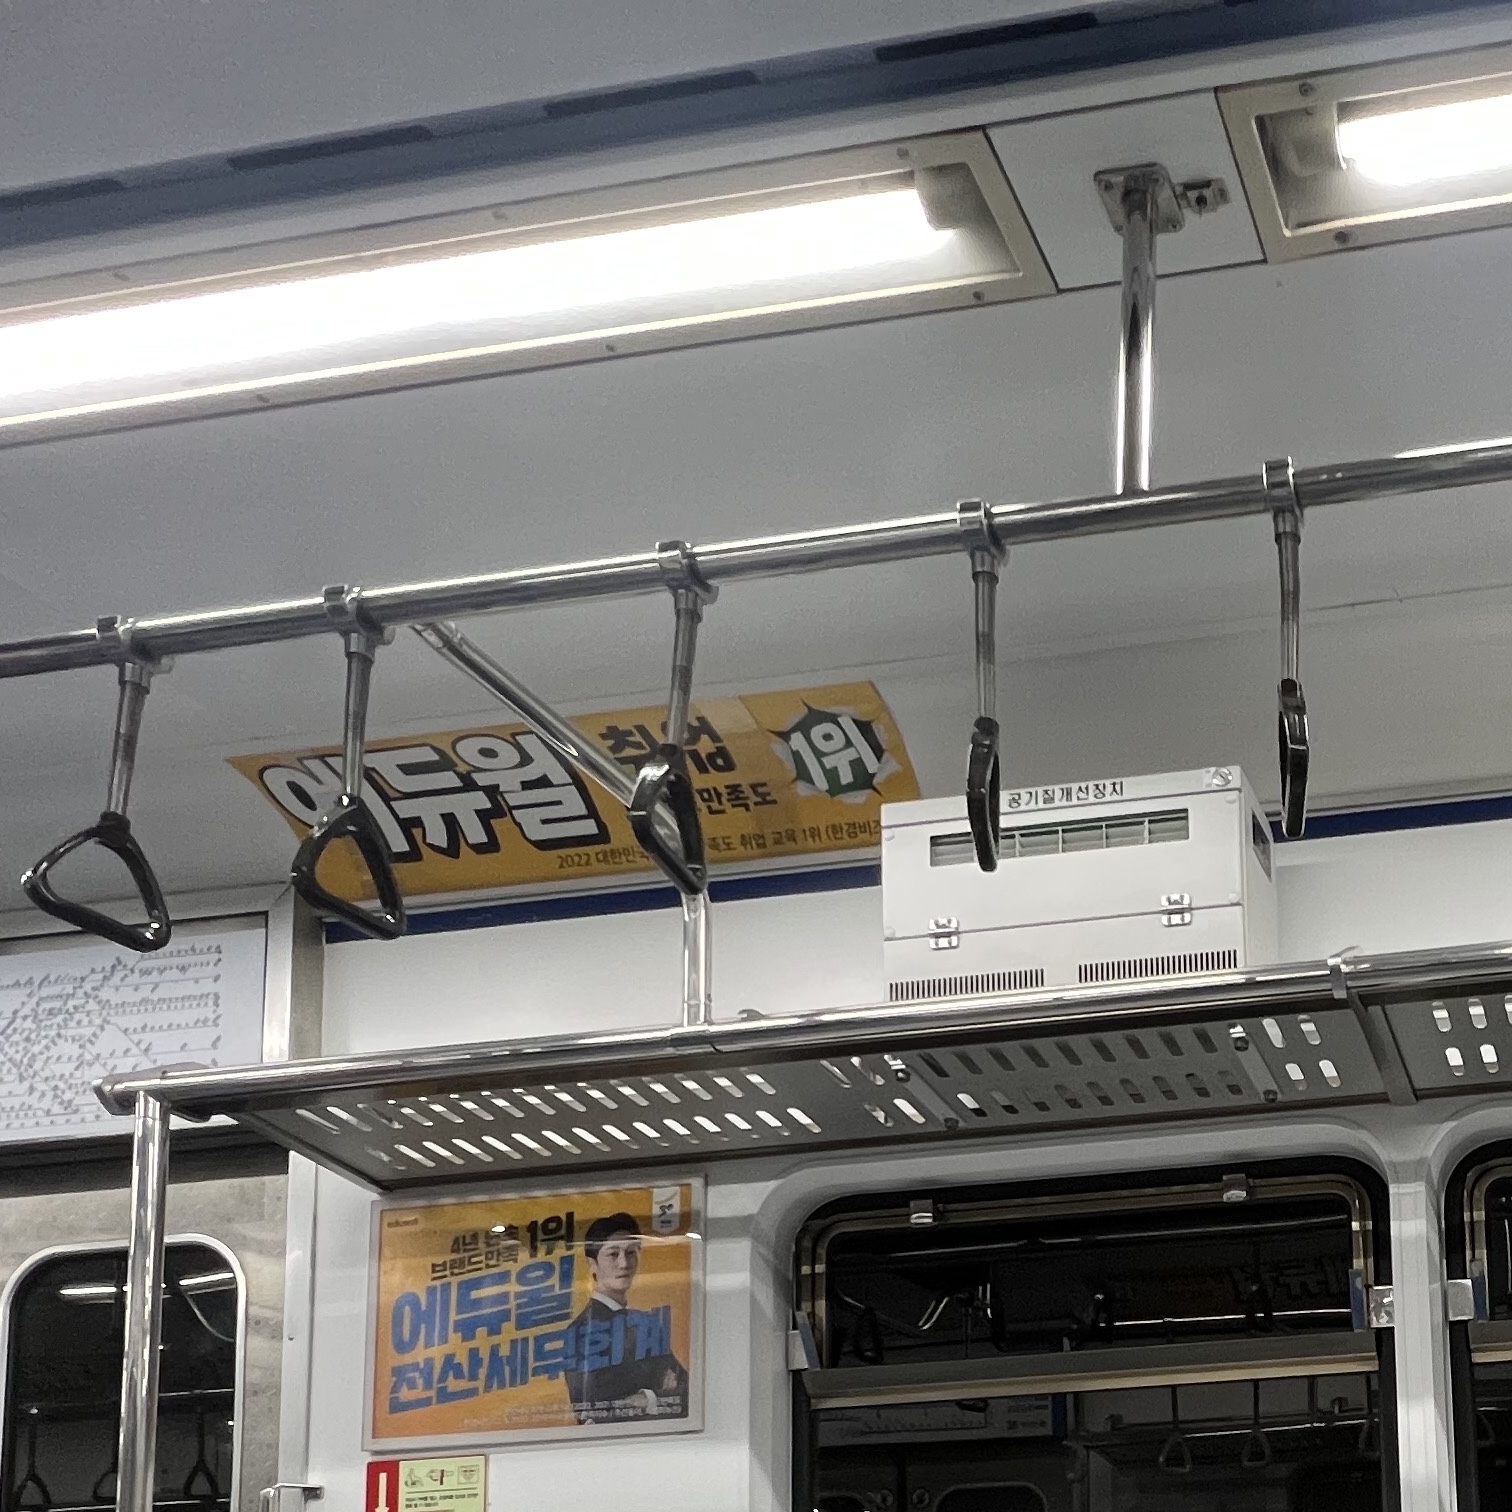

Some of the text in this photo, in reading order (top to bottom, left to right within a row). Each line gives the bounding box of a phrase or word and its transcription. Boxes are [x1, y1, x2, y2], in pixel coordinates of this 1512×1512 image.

[790, 714, 885, 795] 1위
[1007, 780, 1125, 808] 공기질개선장치
[262, 732, 610, 860] 에듀윌
[558, 853, 591, 869] 2022
[740, 832, 766, 849] 취업
[771, 828, 798, 847] 교육
[801, 825, 821, 843] 1위
[526, 1211, 575, 1258] 1위
[391, 1255, 576, 1354] 에듀윌
[389, 1305, 672, 1414] 전산세무회계
